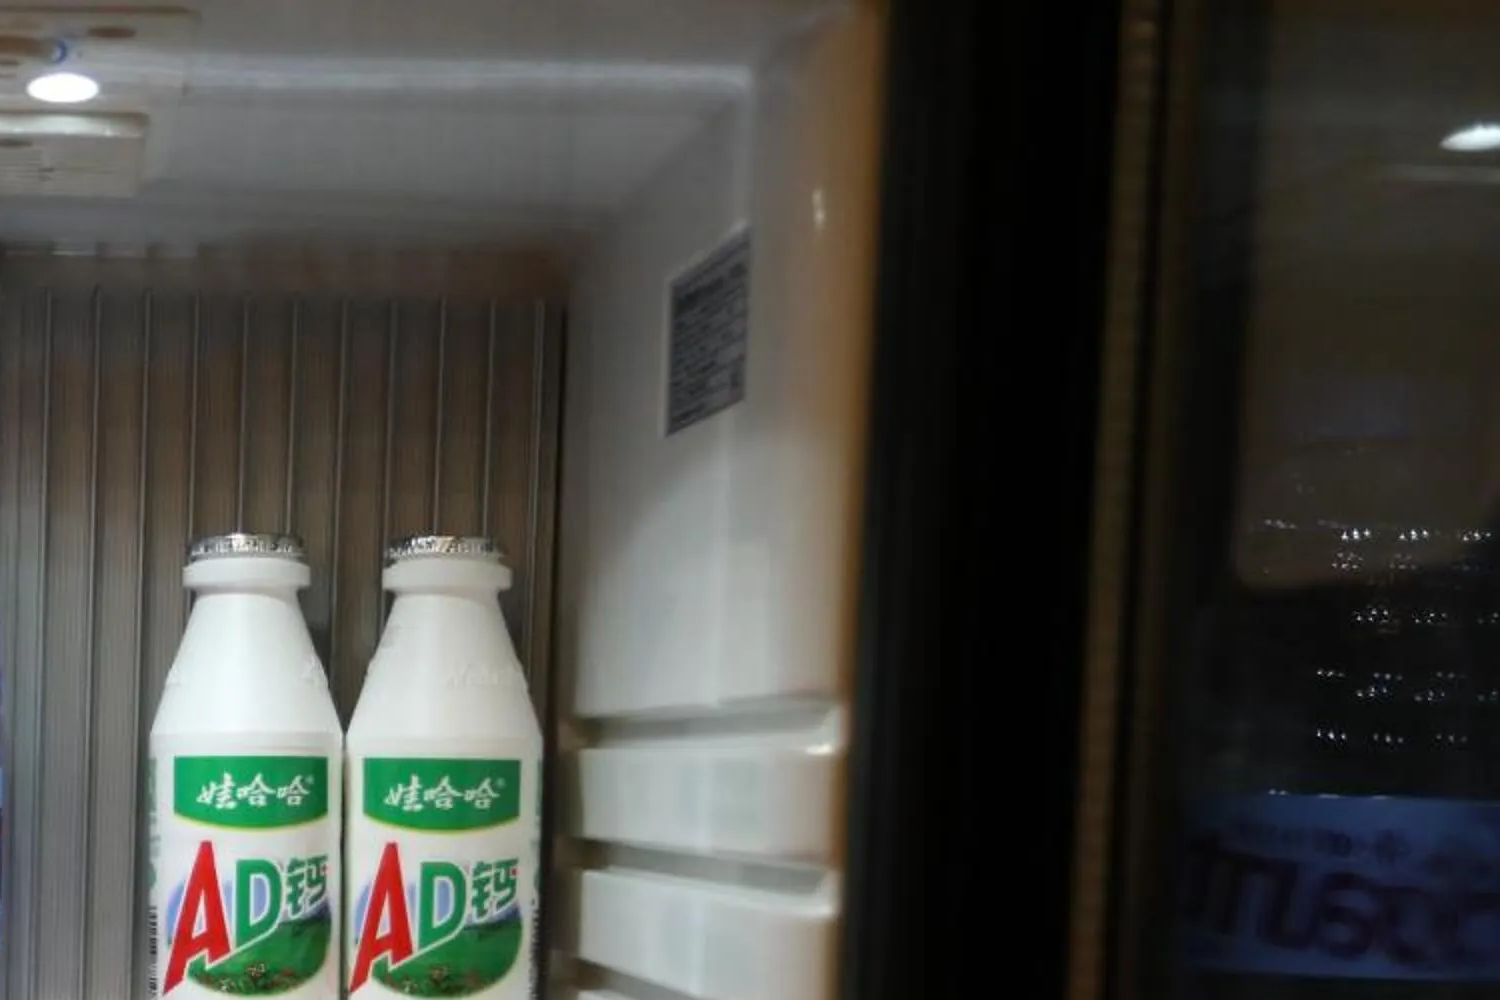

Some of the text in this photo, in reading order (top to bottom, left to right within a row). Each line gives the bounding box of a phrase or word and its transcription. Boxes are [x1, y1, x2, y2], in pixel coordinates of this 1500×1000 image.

[196, 770, 310, 809] 娃哈哈
[384, 774, 499, 812] 娃哈哈
